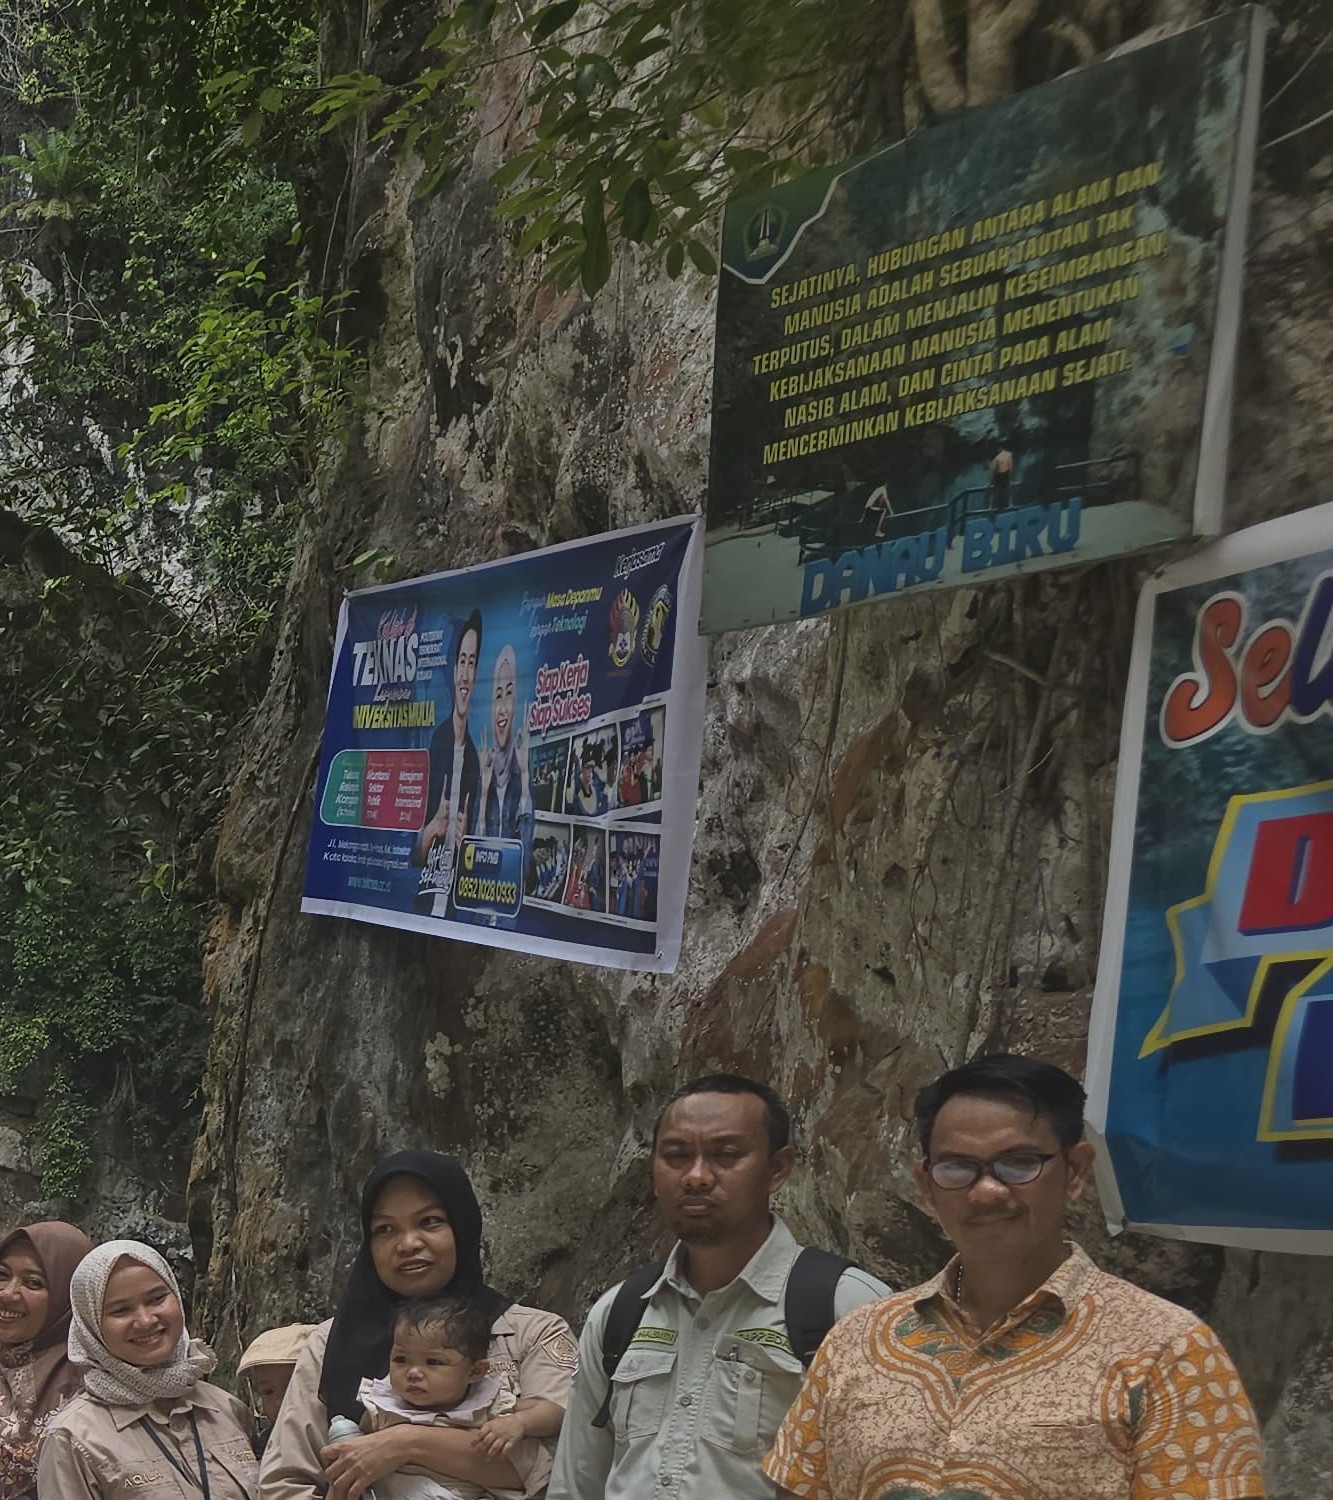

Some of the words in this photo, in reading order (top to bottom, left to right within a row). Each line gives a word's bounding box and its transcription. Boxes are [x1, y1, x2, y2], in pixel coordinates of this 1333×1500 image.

[771, 263, 861, 309] SEJATINYA,
[867, 226, 966, 279] HUBUNGAN
[970, 200, 1046, 245] ANTARA
[1050, 177, 1111, 218] ALAM
[1115, 160, 1162, 197] DAN
[784, 294, 861, 335] MANUSIA
[866, 270, 934, 311] ADALAH
[939, 246, 1010, 288] SEBUAH
[1015, 219, 1090, 264] TAUTAN
[1096, 206, 1134, 238] TAK
[753, 335, 834, 376] TERPUTUS,
[841, 313, 900, 350] DALAM
[906, 282, 1000, 330] MENJALIN
[769, 344, 906, 402] KEBIJAKSANAAN
[911, 317, 996, 361] MANUSIA
[1003, 274, 1140, 335] MENENTUKAN
[784, 396, 835, 429] NASIB
[839, 381, 891, 414] ALAM,
[898, 367, 935, 398] DAN
[941, 351, 993, 386] CINTA
[999, 335, 1049, 370] PADA
[1055, 317, 1113, 353] ALAM
[763, 410, 899, 465] MENCERMINKAN
[904, 367, 1059, 428] KEBIJAKSANAAN
[801, 527, 948, 616] DANAU
[962, 496, 1083, 574] BIRU
[353, 633, 419, 687] TEKNAS
